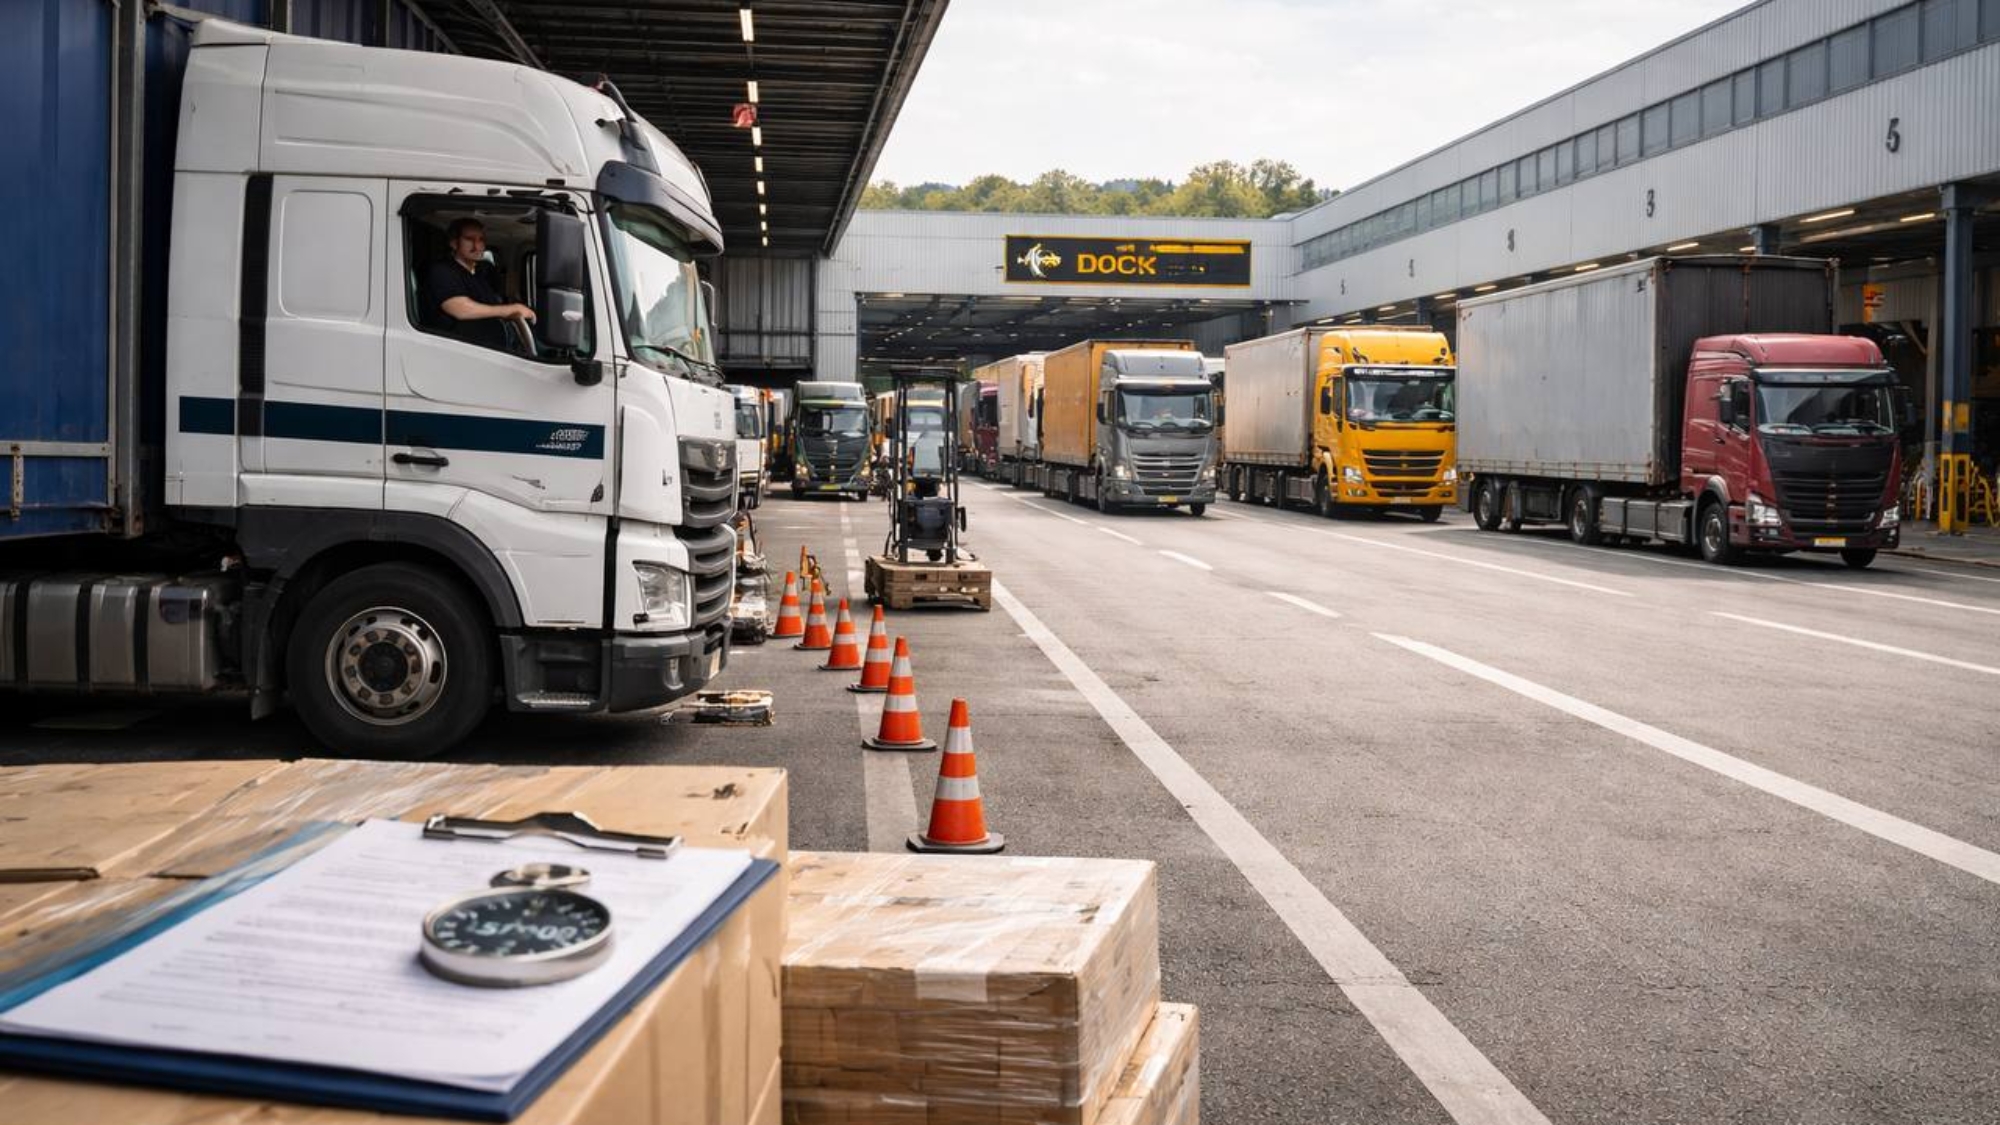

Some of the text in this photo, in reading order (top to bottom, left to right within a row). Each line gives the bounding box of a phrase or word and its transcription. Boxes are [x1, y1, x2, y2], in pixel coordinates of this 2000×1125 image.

[1885, 117, 1901, 154] 5
[1646, 188, 1656, 218] 3
[1077, 252, 1158, 276] DOCK
